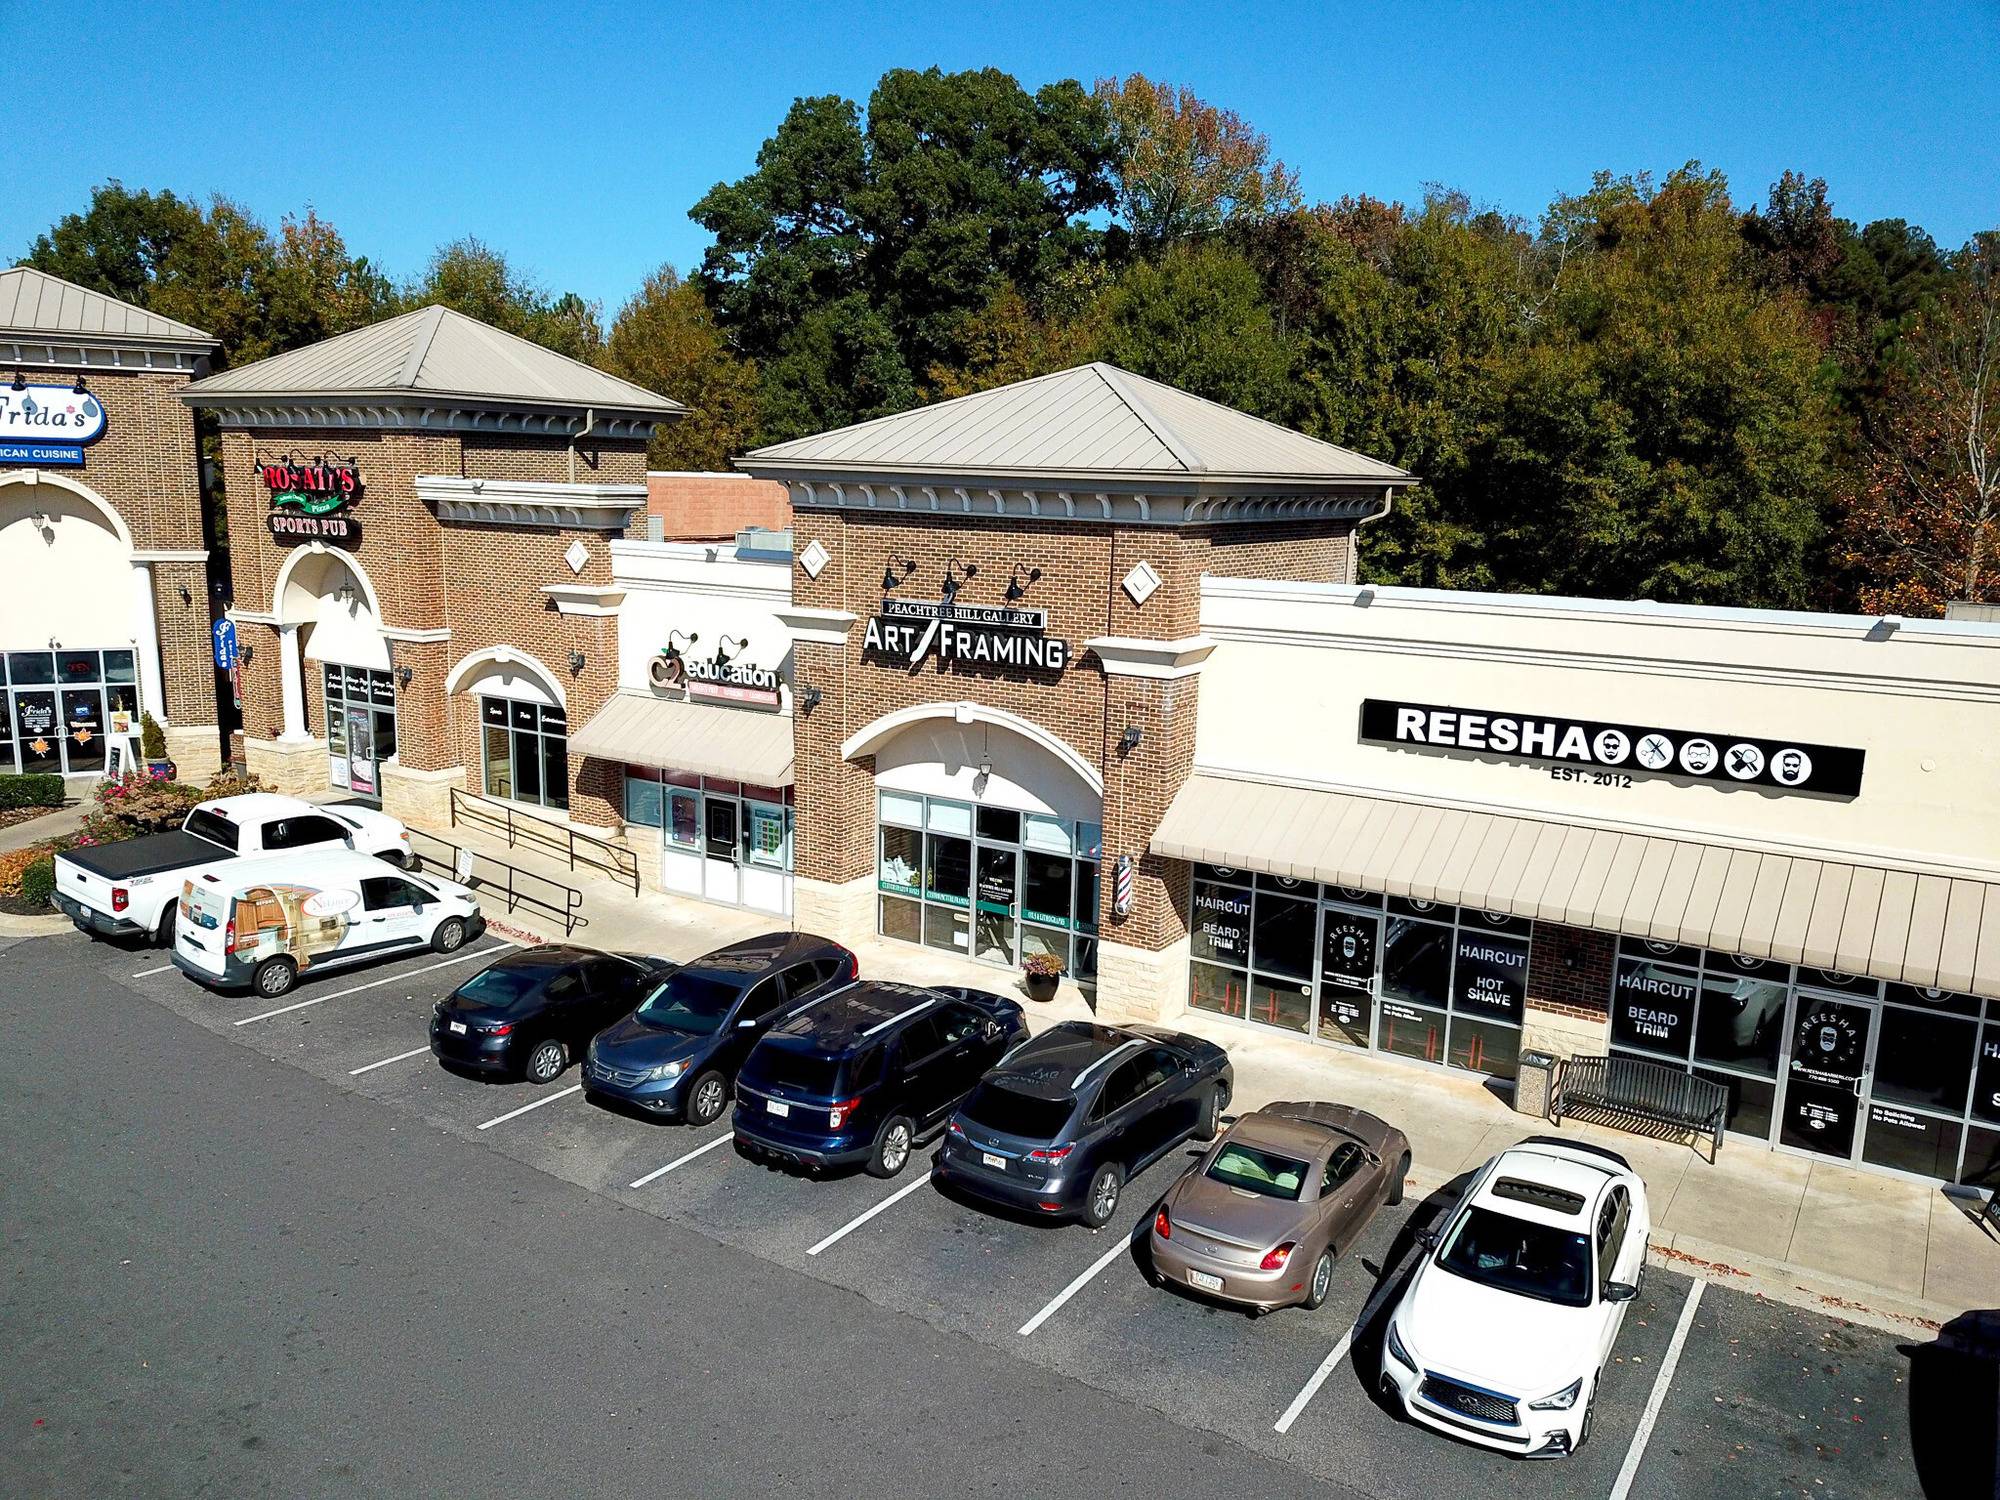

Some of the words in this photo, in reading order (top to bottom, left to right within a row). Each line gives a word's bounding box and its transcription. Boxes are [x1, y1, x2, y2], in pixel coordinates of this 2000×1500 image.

[32, 449, 79, 459] CUISINE
[272, 516, 318, 535] SPORTS
[321, 519, 348, 536] PUB
[888, 603, 952, 617] PEACHTREE
[954, 610, 981, 621] HILL
[982, 610, 1035, 624] GALLERY
[863, 617, 914, 653] ART
[940, 623, 1064, 668] FRAMING
[687, 660, 777, 688] education
[1396, 707, 1592, 761] REESHA
[1550, 766, 1588, 783] EST.
[1593, 771, 1633, 789] 2012
[1195, 895, 1250, 916] HAIRCUT
[1202, 922, 1240, 939] BEARD
[1329, 925, 1370, 945] REESHA
[1208, 935, 1234, 950] TRIM
[1460, 944, 1526, 968] HAIRCUT
[1476, 976, 1505, 991] HOT
[1619, 974, 1694, 1000] HAIRCUT
[1467, 987, 1511, 1007] SHAVE
[1628, 1006, 1678, 1026] BEARD
[1801, 1013, 1857, 1037] REESHA
[1634, 1020, 1669, 1039] TRIM
[1873, 1107, 1883, 1115] No
[1883, 1116, 1898, 1125] Pets
[1899, 1119, 1926, 1130] Allowed
